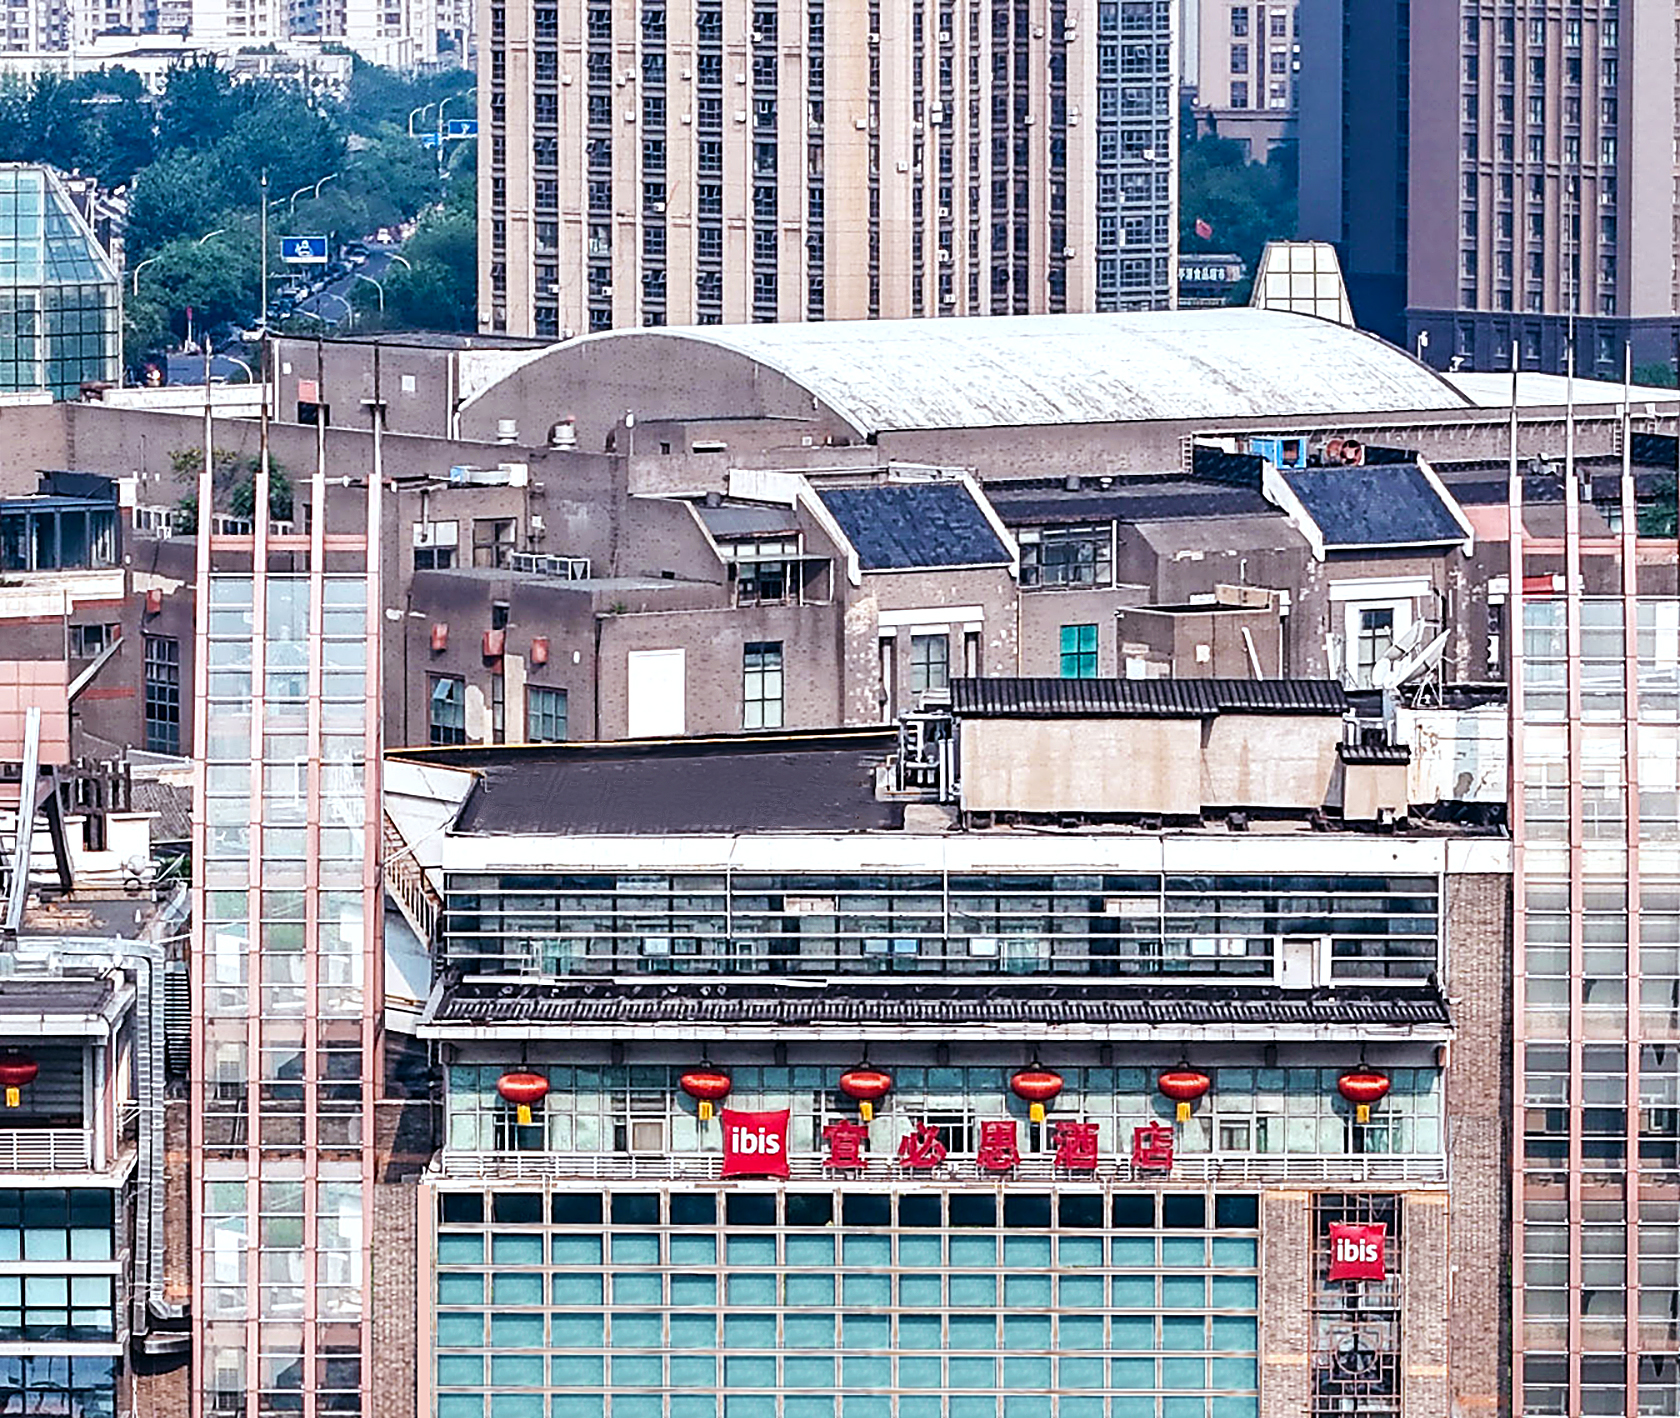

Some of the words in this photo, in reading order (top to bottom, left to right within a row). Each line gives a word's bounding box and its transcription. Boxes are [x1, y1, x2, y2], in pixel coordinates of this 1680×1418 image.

[732, 1126, 780, 1154] ibis
[822, 1119, 1175, 1169] 宜必思酒店
[1337, 1238, 1378, 1262] ibis
